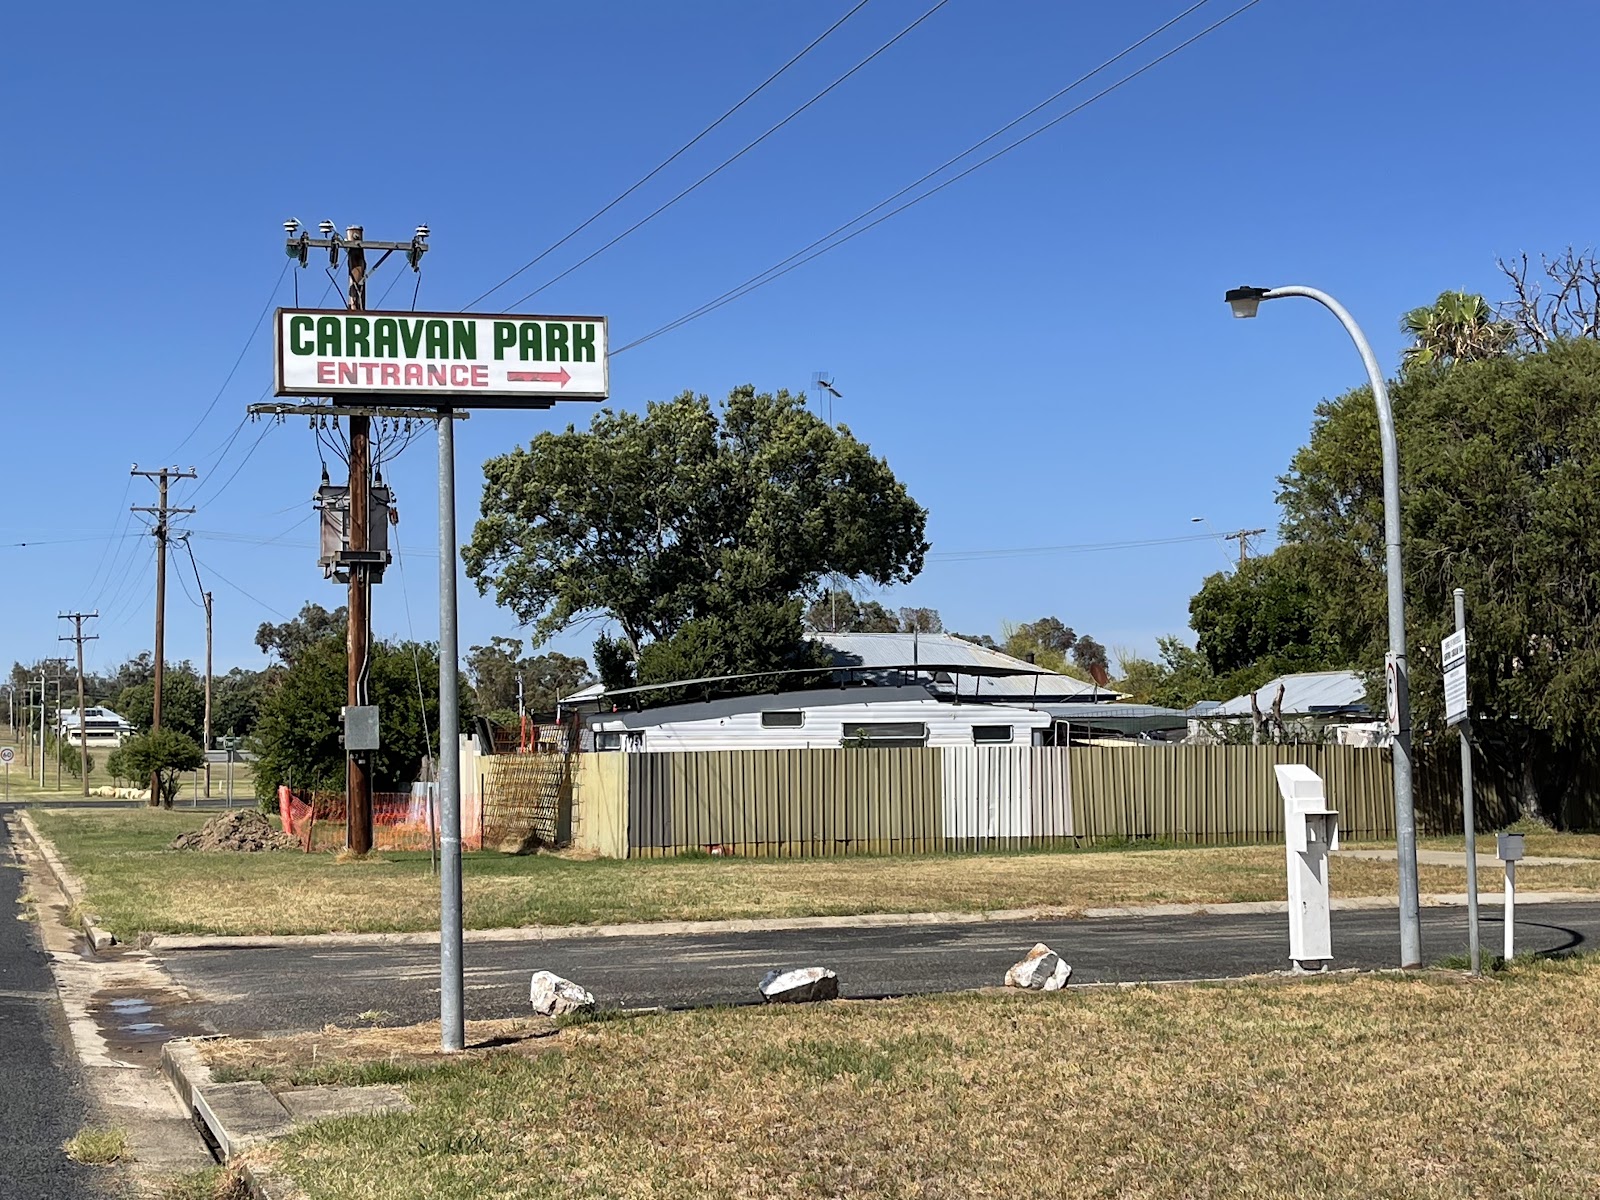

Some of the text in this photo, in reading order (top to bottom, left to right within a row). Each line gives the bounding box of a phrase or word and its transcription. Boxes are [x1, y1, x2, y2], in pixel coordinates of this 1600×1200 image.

[290, 316, 596, 363] CARAVAN PARK
[317, 361, 489, 387] ENTRANCE
